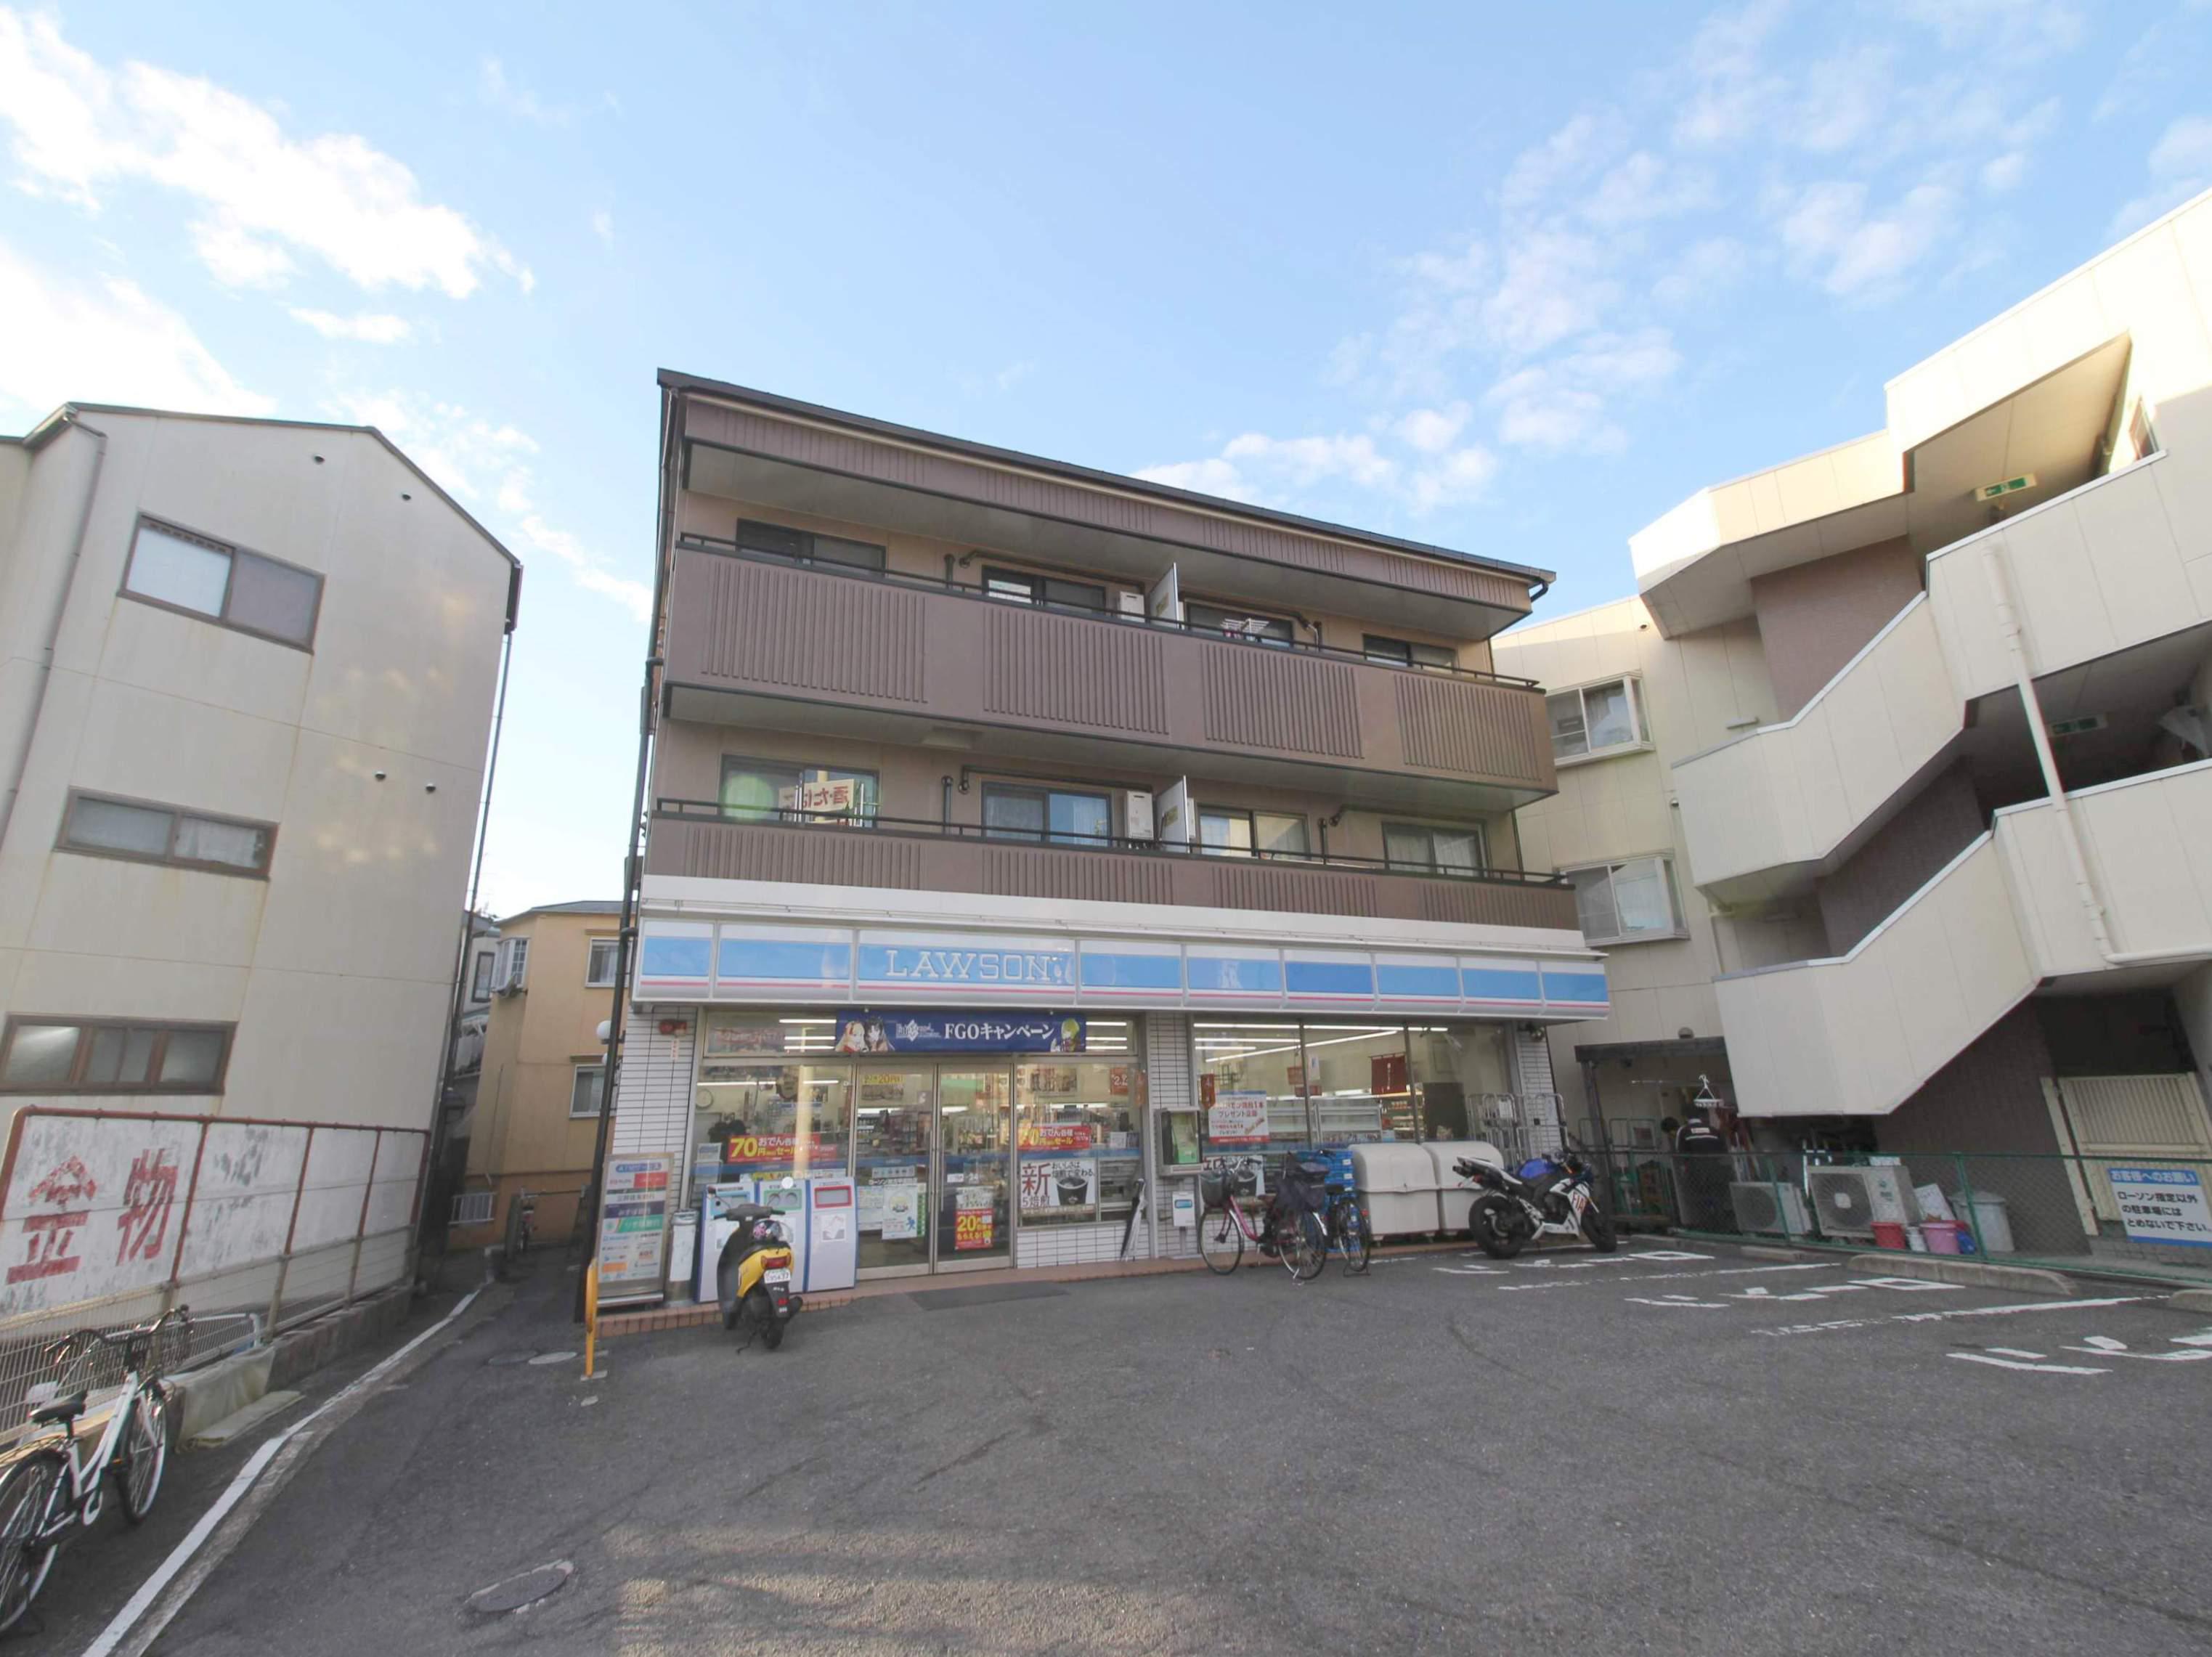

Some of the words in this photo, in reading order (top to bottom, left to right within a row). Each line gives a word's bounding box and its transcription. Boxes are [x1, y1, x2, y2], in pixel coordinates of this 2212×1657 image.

[885, 949, 1052, 981] LAWSON
[944, 1022, 1054, 1041] FGOキャンペーン
[731, 1138, 758, 1157] 70
[1022, 1163, 1052, 1196] 新
[2117, 1191, 2198, 1204] ローソン指定以外
[2121, 1205, 2183, 1216] の駐車場には
